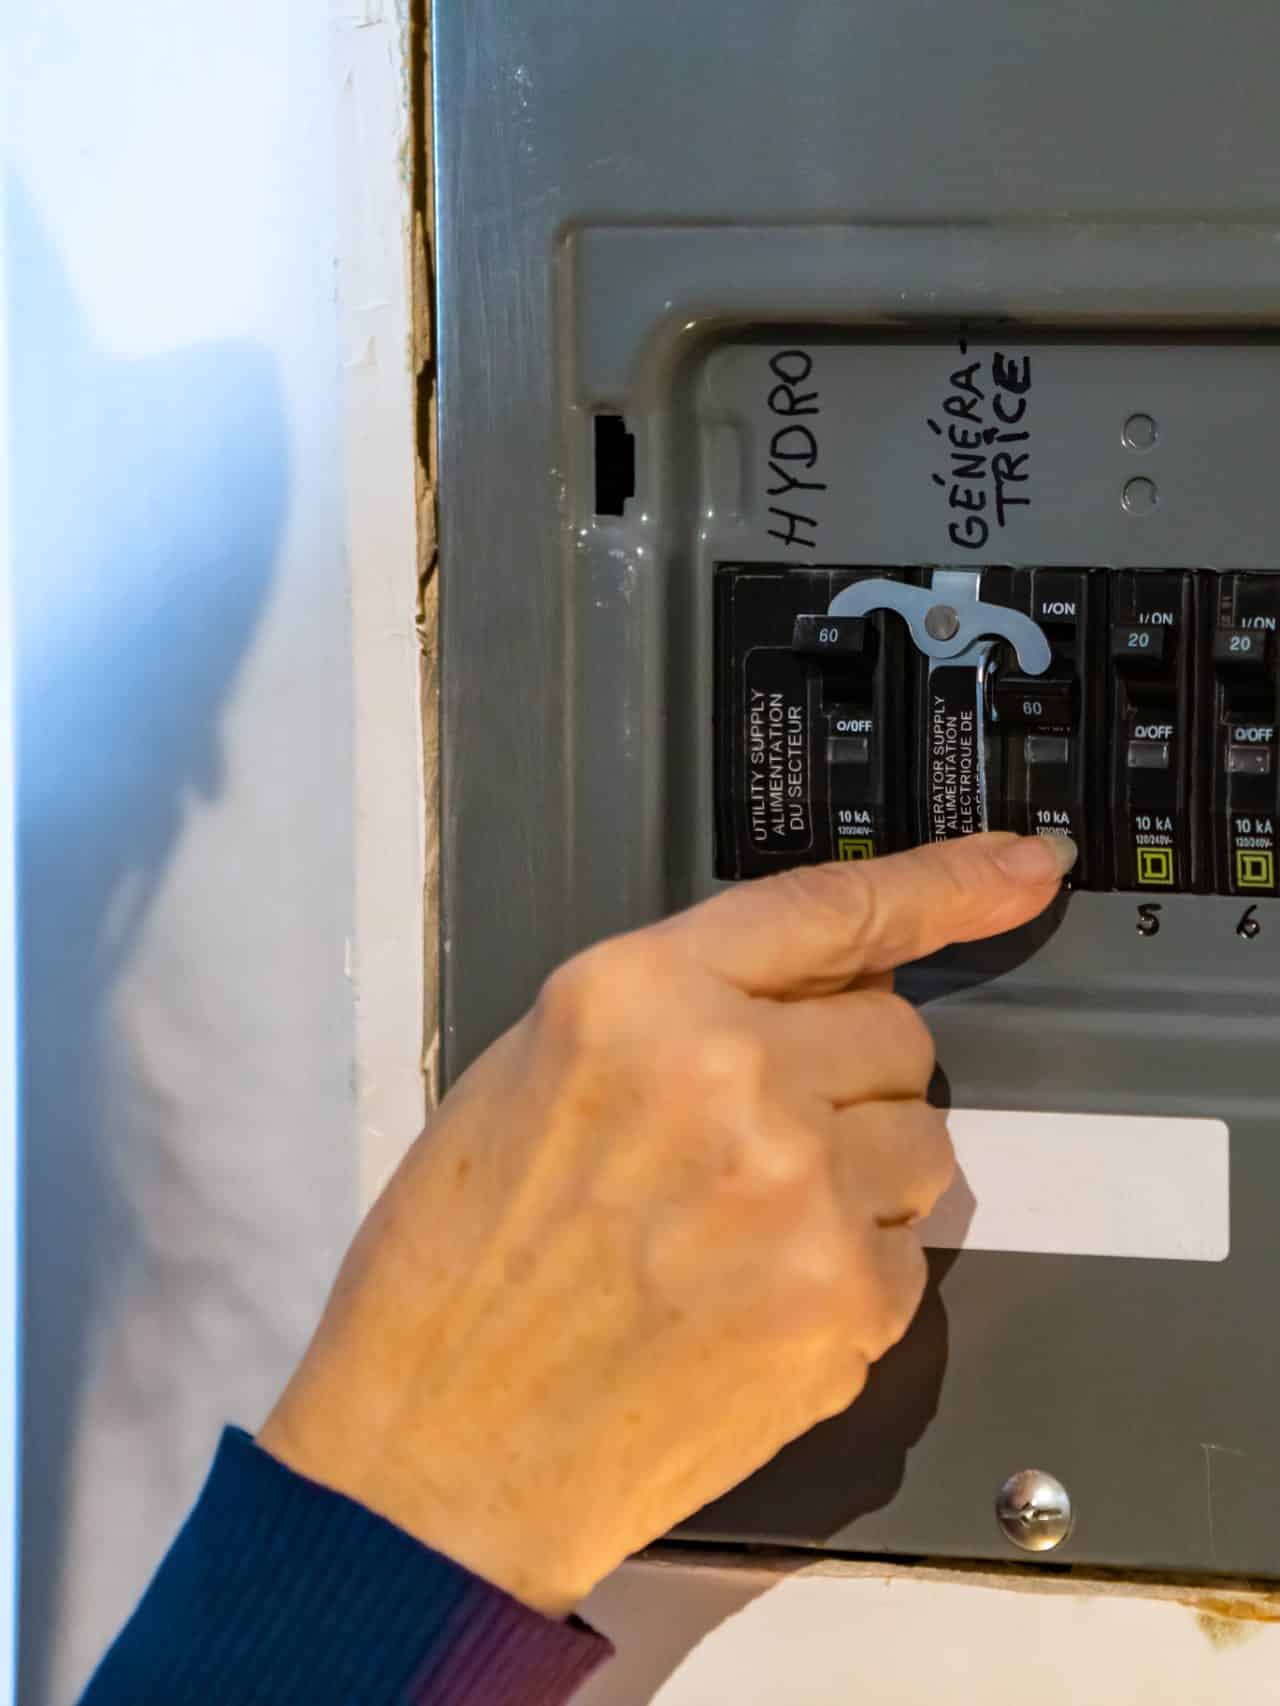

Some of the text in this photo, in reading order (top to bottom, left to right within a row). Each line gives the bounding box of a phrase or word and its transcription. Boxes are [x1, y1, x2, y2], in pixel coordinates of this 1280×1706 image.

[991, 351, 1031, 527] TRICE
[767, 350, 827, 547] HYDRO
[1042, 602, 1076, 615] I/ON
[819, 628, 839, 643] 60
[1127, 633, 1150, 647] 20
[1229, 636, 1251, 650] 20
[1023, 701, 1042, 715] 60
[836, 720, 873, 733] O/OFF
[960, 710, 973, 732] DE
[1134, 725, 1174, 739] O/OFF
[1235, 728, 1273, 742] O/OFF
[751, 689, 768, 841] UTILITY SUPPLY
[769, 693, 786, 837] ALIMENTATION
[788, 705, 804, 831] DU SECTEUR
[933, 695, 946, 843] ENERATOR SUPPLY
[945, 715, 958, 830] ALIMENTATION
[838, 810, 872, 824] 10 kA
[1037, 810, 1070, 825] 10 kA
[1136, 816, 1173, 831] 10 kA
[1235, 818, 1273, 834] 10 kA
[1136, 903, 1162, 936] 5
[1237, 904, 1261, 938] 6
